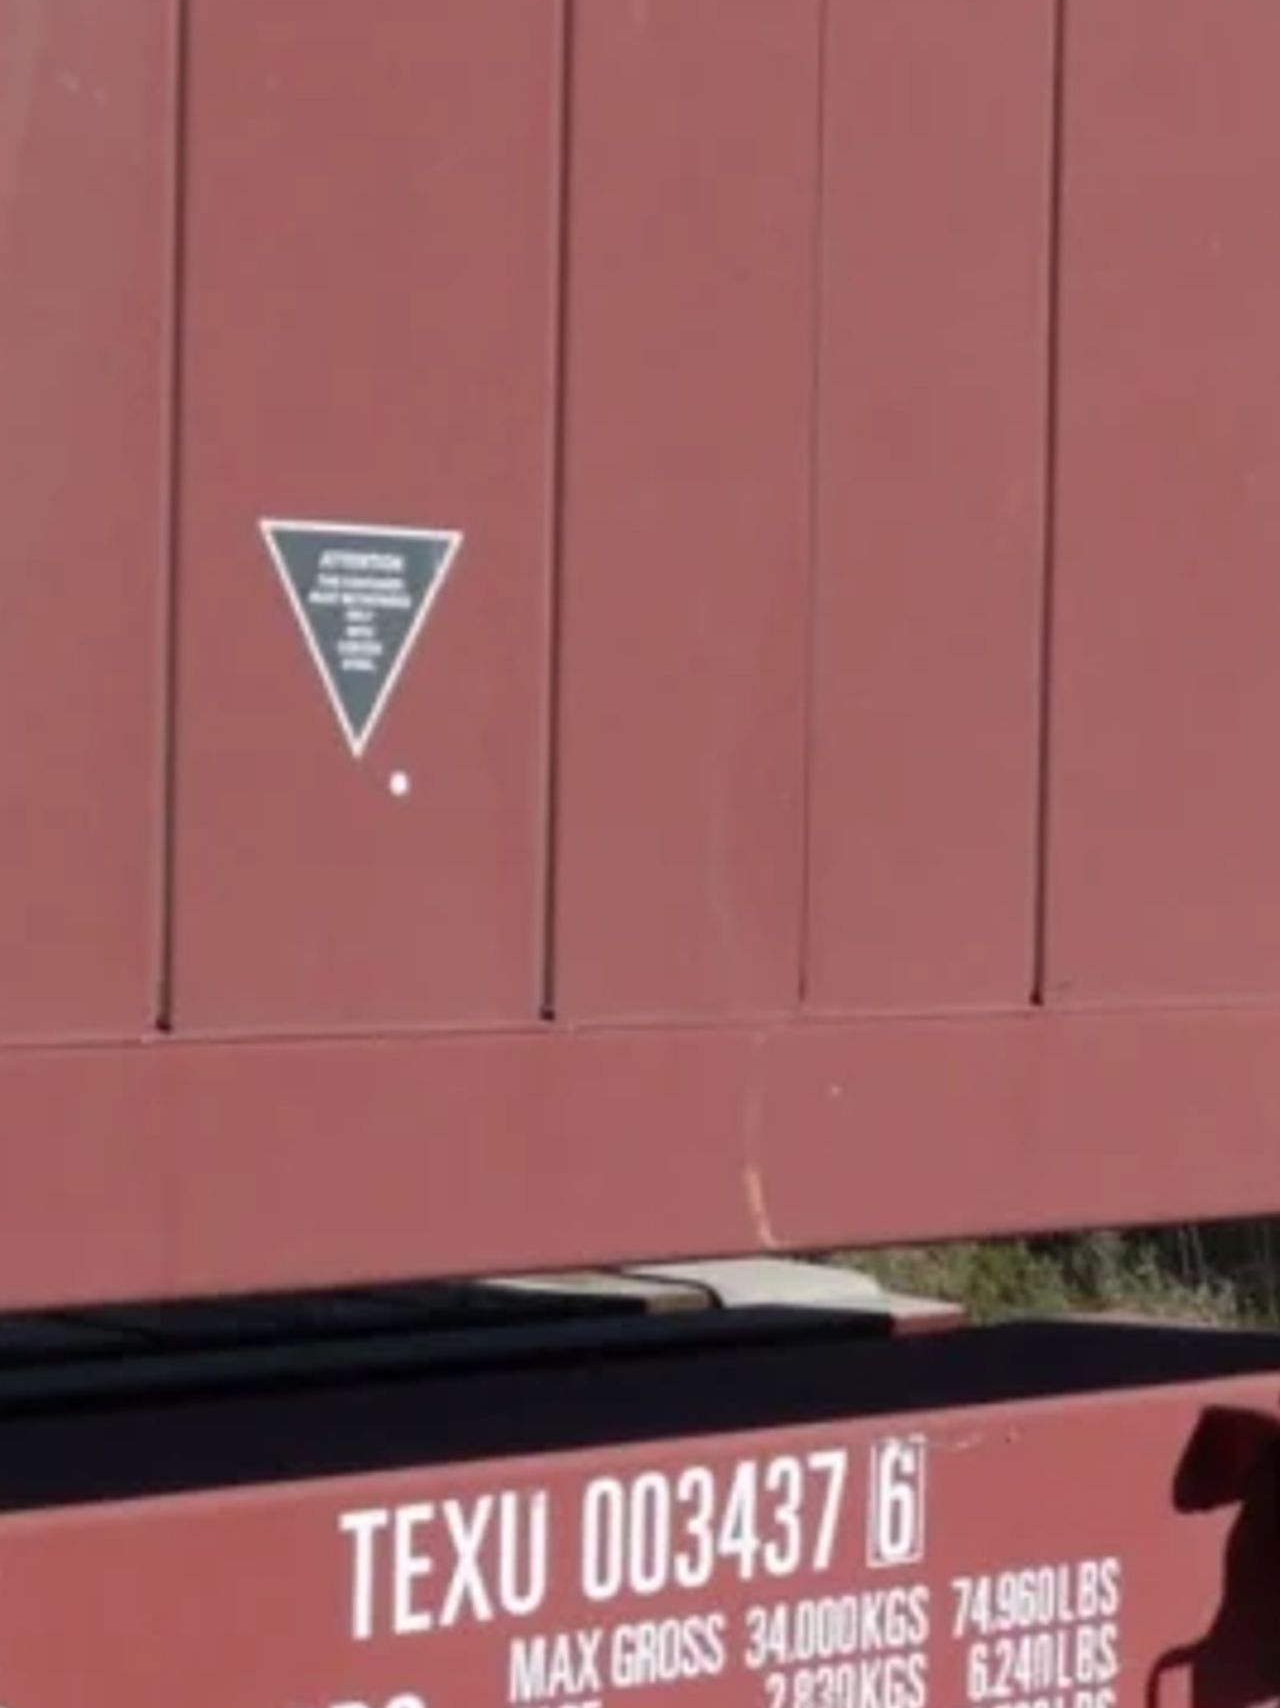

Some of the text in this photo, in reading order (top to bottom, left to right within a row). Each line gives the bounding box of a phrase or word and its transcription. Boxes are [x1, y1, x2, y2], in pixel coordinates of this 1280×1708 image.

[338, 1438, 918, 1640] TEXU 003437 6
[508, 1629, 603, 1704] MAX
[610, 1612, 726, 1689] GROSS
